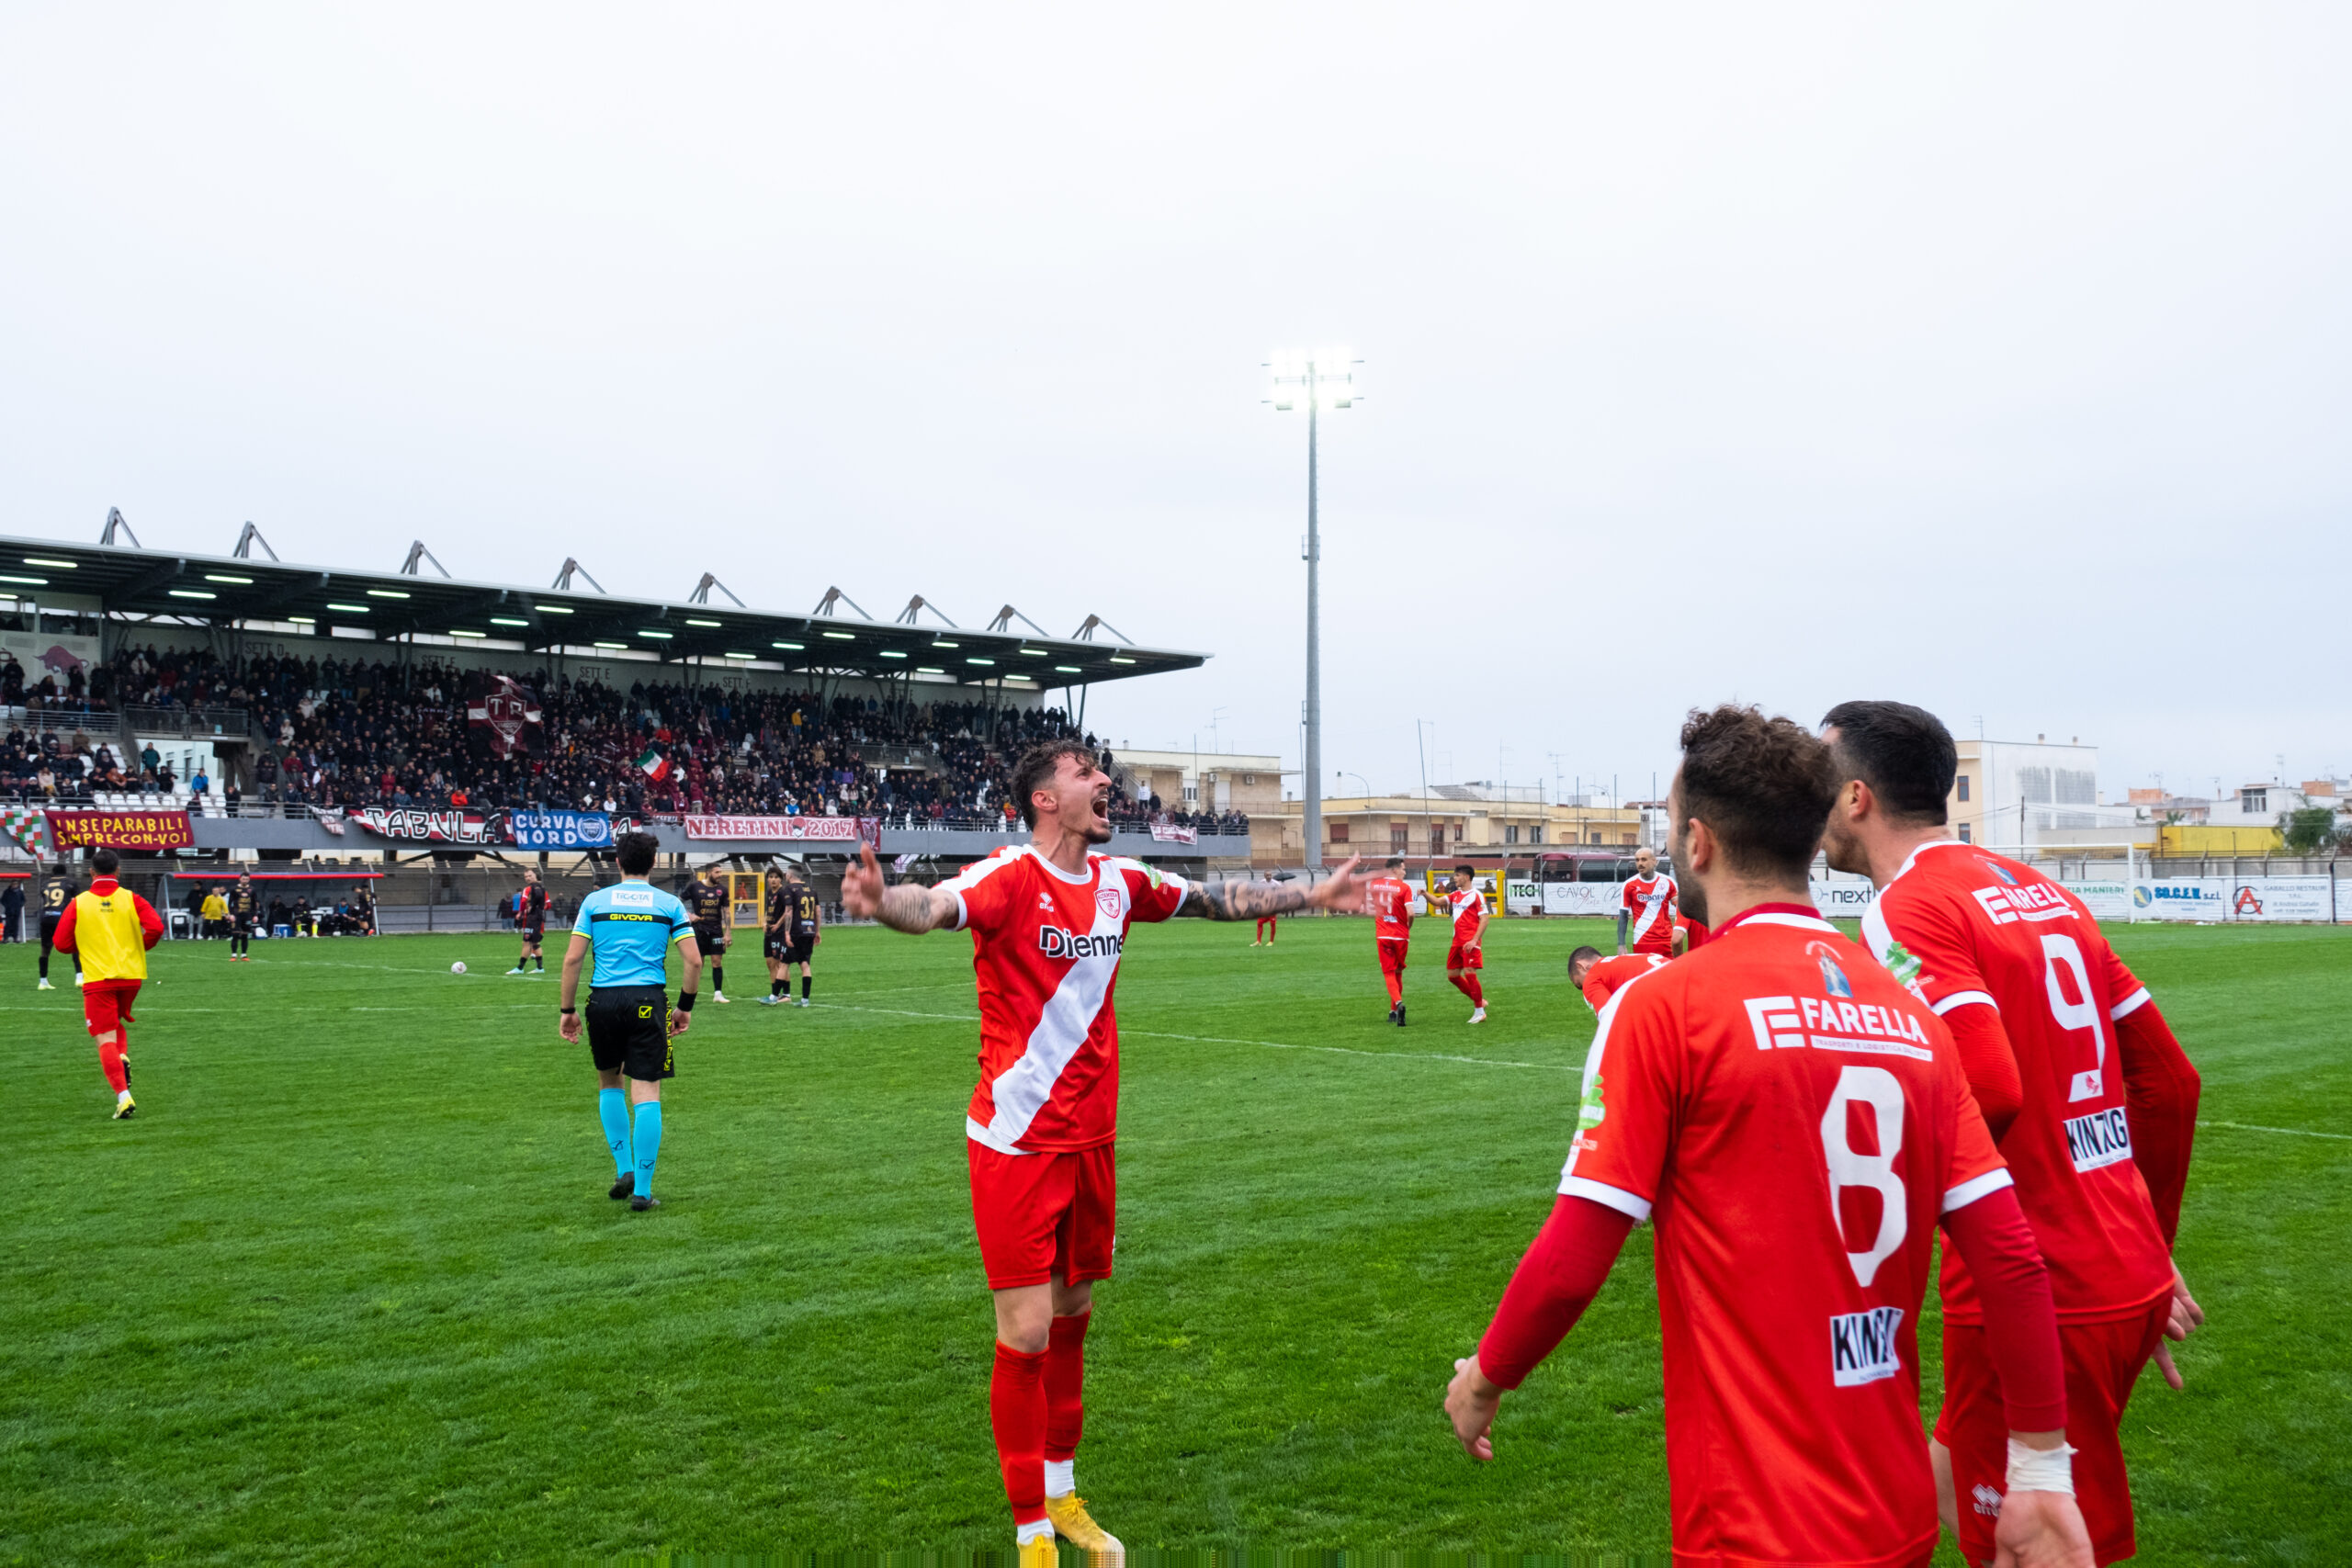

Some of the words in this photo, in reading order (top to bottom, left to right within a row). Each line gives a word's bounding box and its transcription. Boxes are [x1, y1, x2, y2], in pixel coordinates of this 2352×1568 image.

[605, 668, 611, 680] E
[56, 817, 183, 832] INSEPARABILI
[515, 814, 576, 829] CURVA
[689, 818, 789, 837] NERETINI
[808, 820, 854, 837] 2017
[516, 829, 578, 844] NORD
[1832, 885, 1872, 904] next
[609, 913, 653, 921] GIVOVA
[1039, 925, 1124, 959] Dienne
[1800, 996, 1929, 1045] FARELLA
[2039, 933, 2106, 1103] 9
[1820, 1066, 1908, 1288] 8
